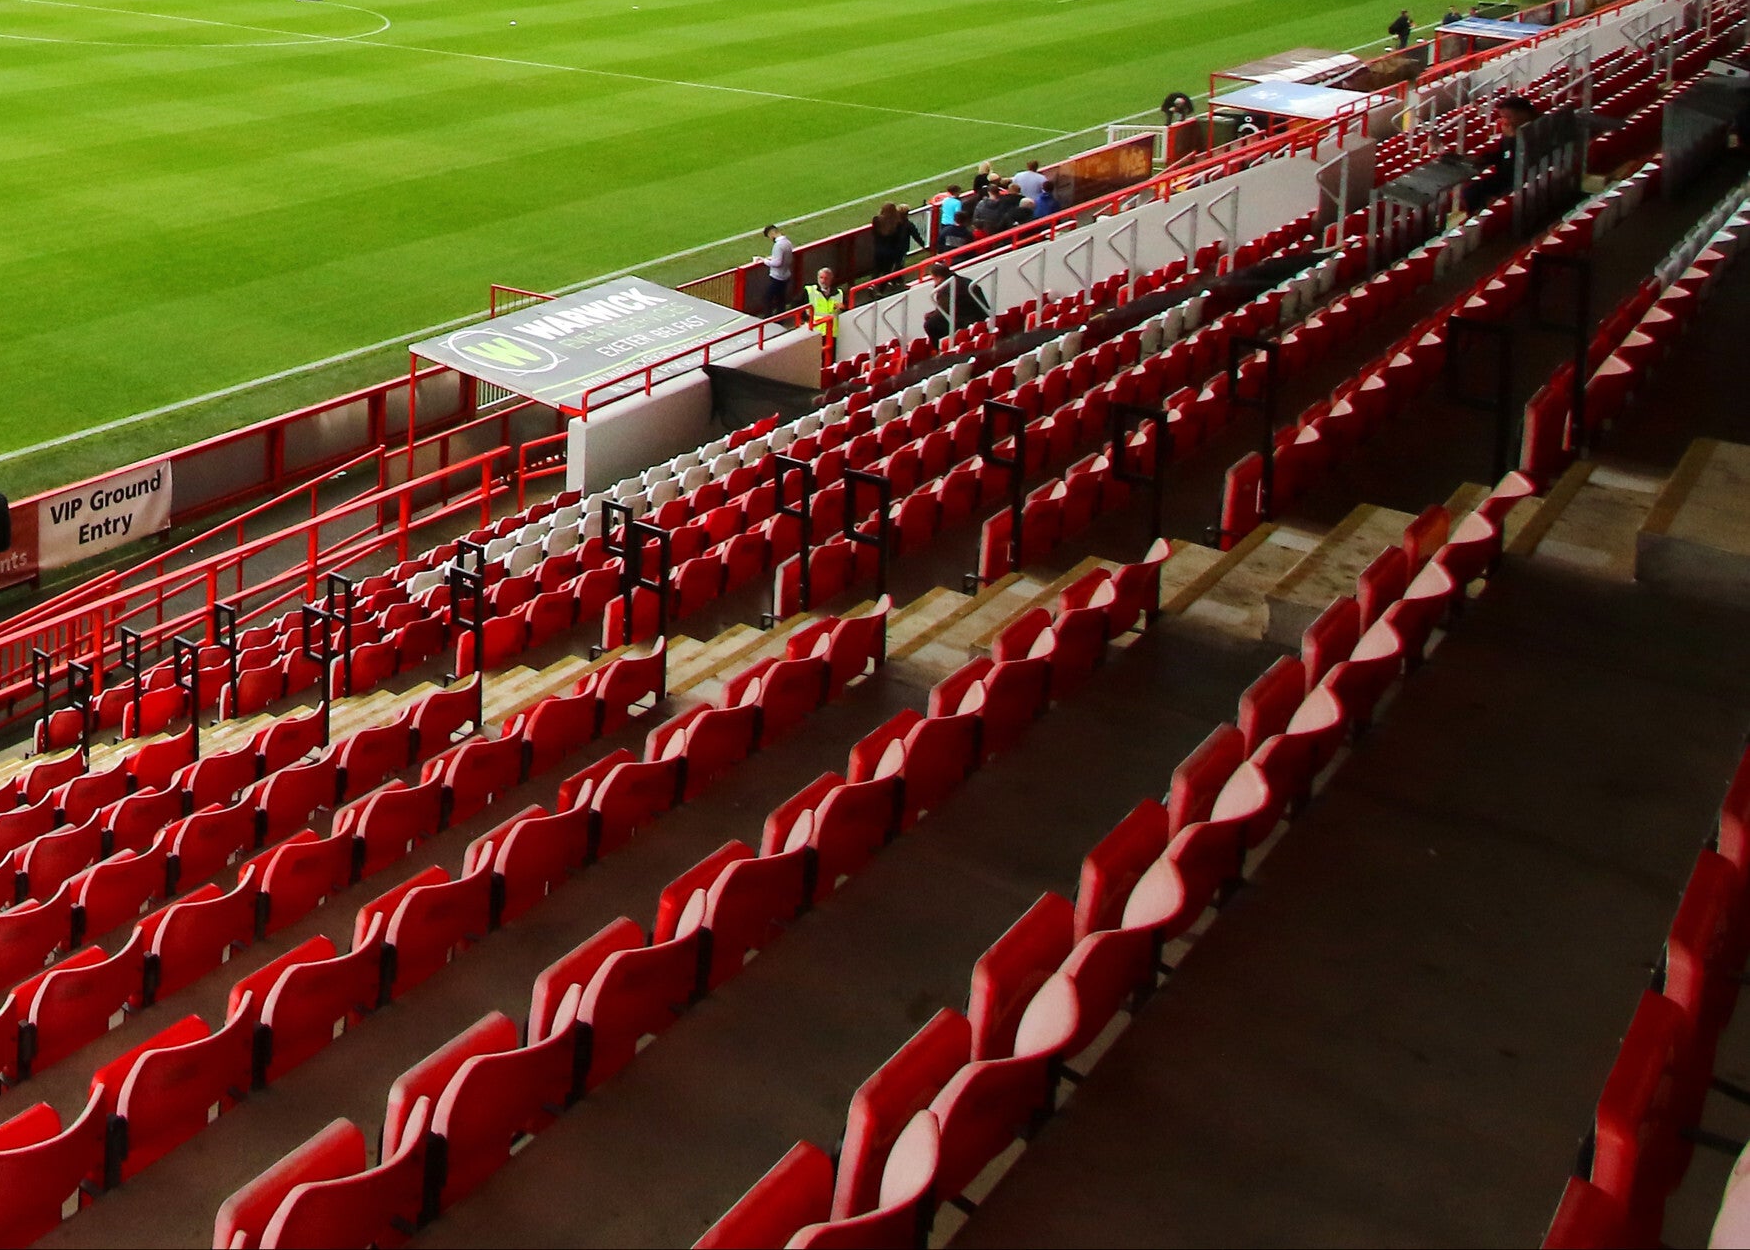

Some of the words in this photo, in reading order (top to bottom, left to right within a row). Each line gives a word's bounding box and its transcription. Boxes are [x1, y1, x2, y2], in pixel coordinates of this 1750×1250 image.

[512, 286, 667, 341] WARWICK
[462, 337, 542, 367] W
[596, 333, 654, 358] EXETER
[649, 314, 710, 338] BELFAST
[50, 497, 83, 525] VIP
[90, 469, 161, 511] Ground
[79, 513, 133, 545] Entry
